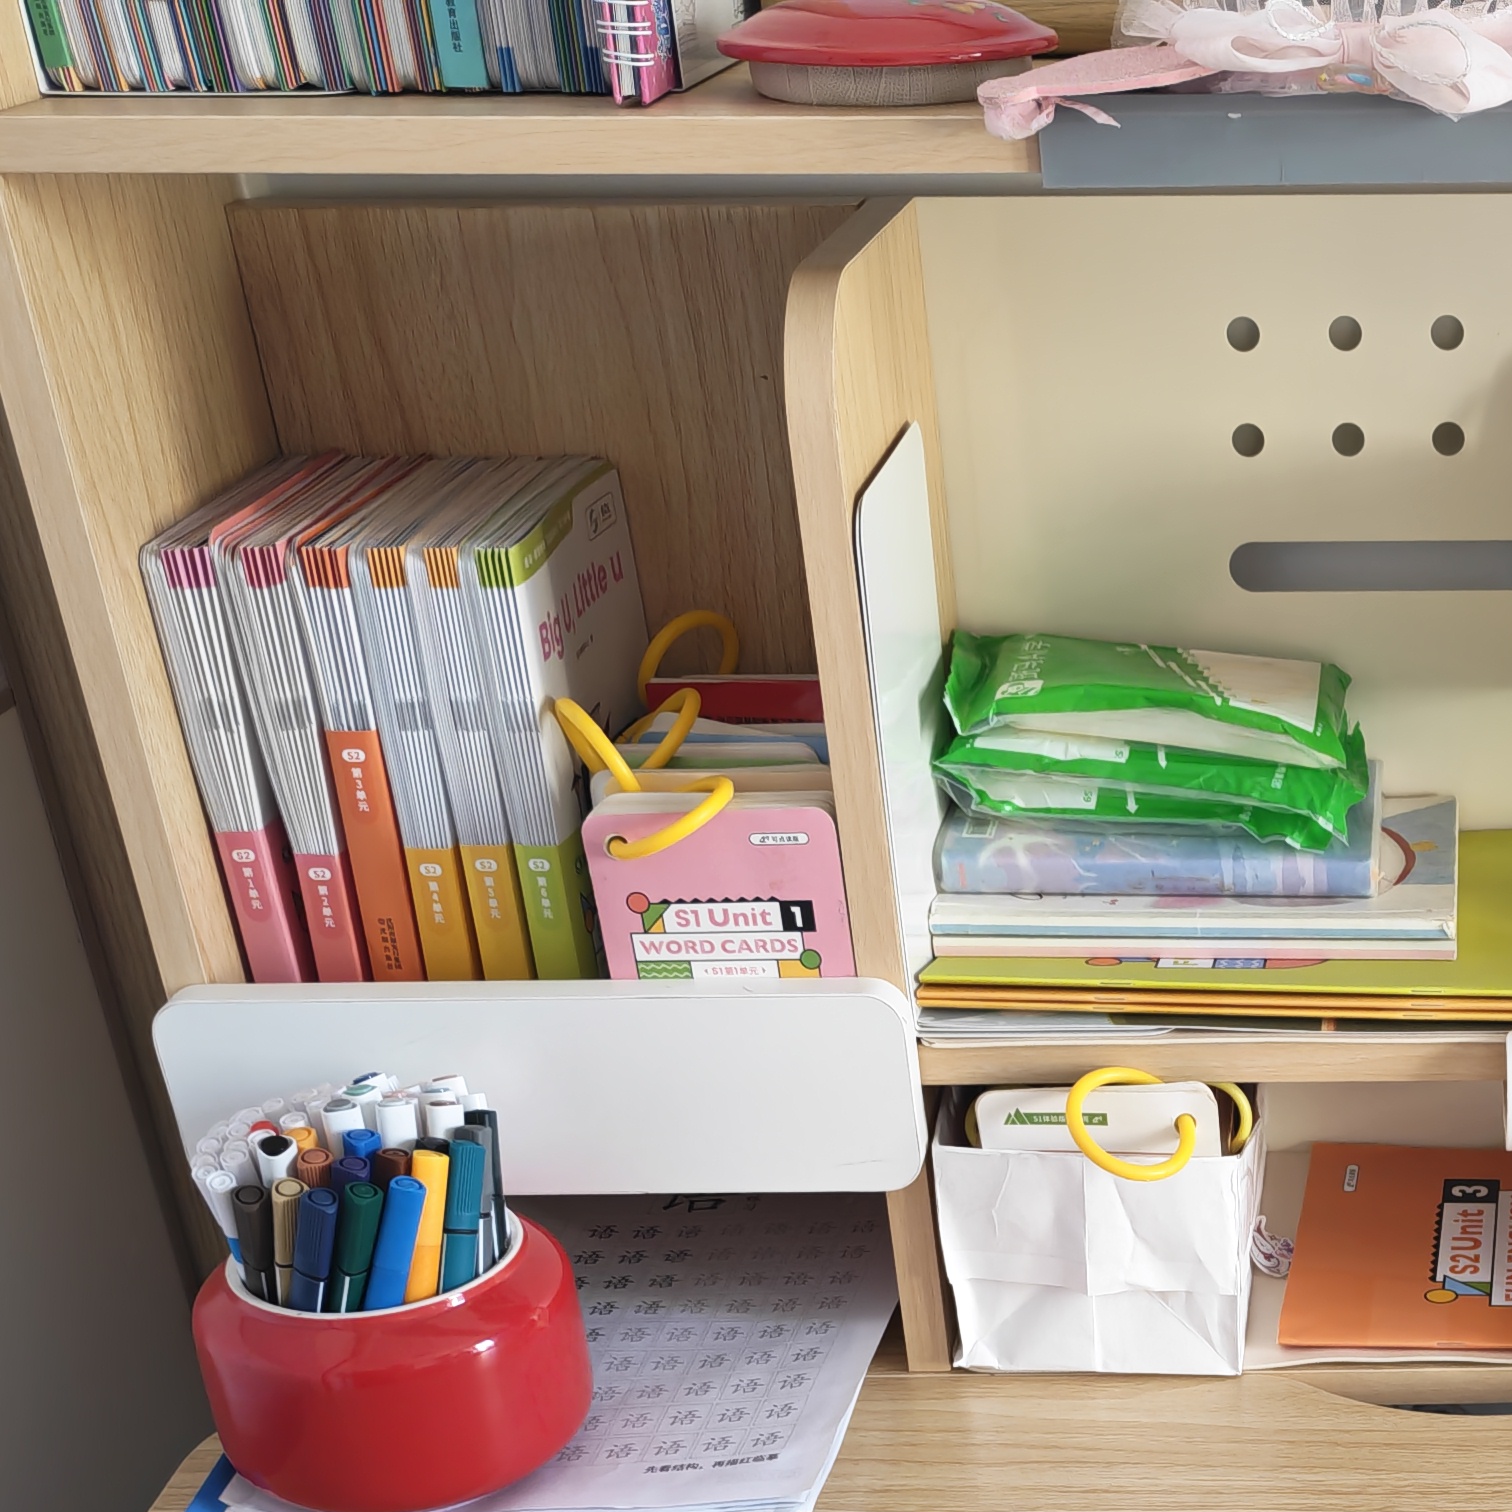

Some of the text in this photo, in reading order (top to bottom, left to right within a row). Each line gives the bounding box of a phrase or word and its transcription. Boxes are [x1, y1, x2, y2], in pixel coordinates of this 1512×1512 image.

[539, 611, 565, 662] Big
[347, 752, 360, 760] S2
[236, 852, 251, 860] S2
[480, 861, 493, 869] S2
[533, 861, 545, 869] S2
[313, 870, 326, 878] S2
[424, 866, 437, 874] S2
[674, 906, 803, 928] S1 Unit 1
[639, 938, 799, 955] WORD CARDS
[1449, 1185, 1489, 1275] S2 Unit 3
